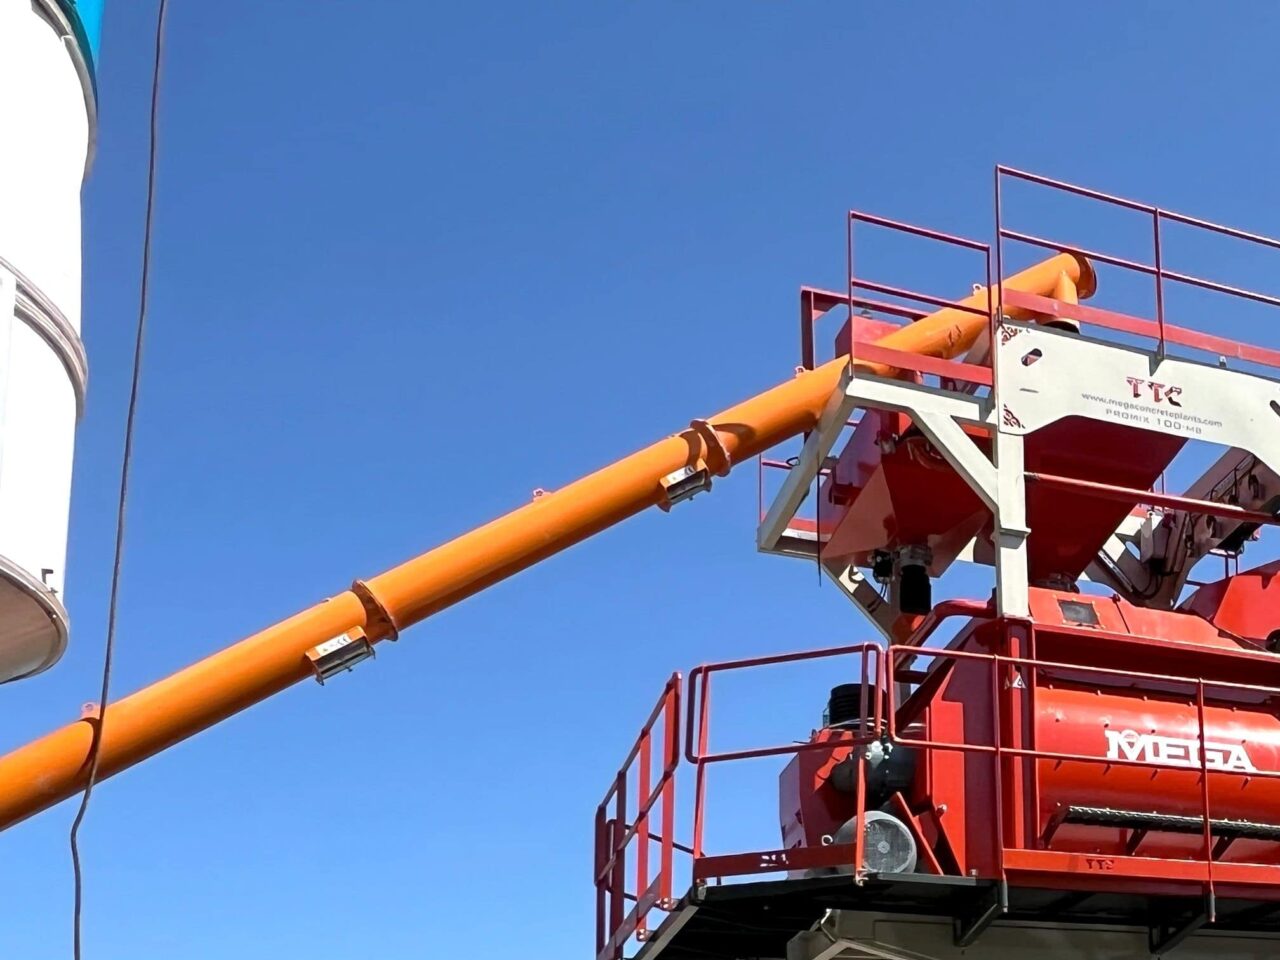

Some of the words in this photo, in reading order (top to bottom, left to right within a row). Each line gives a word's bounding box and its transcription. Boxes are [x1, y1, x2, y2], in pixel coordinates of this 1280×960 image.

[1126, 377, 1182, 407] TTC
[1106, 409, 1150, 424] PROMIX
[1105, 729, 1258, 773] MEGA
